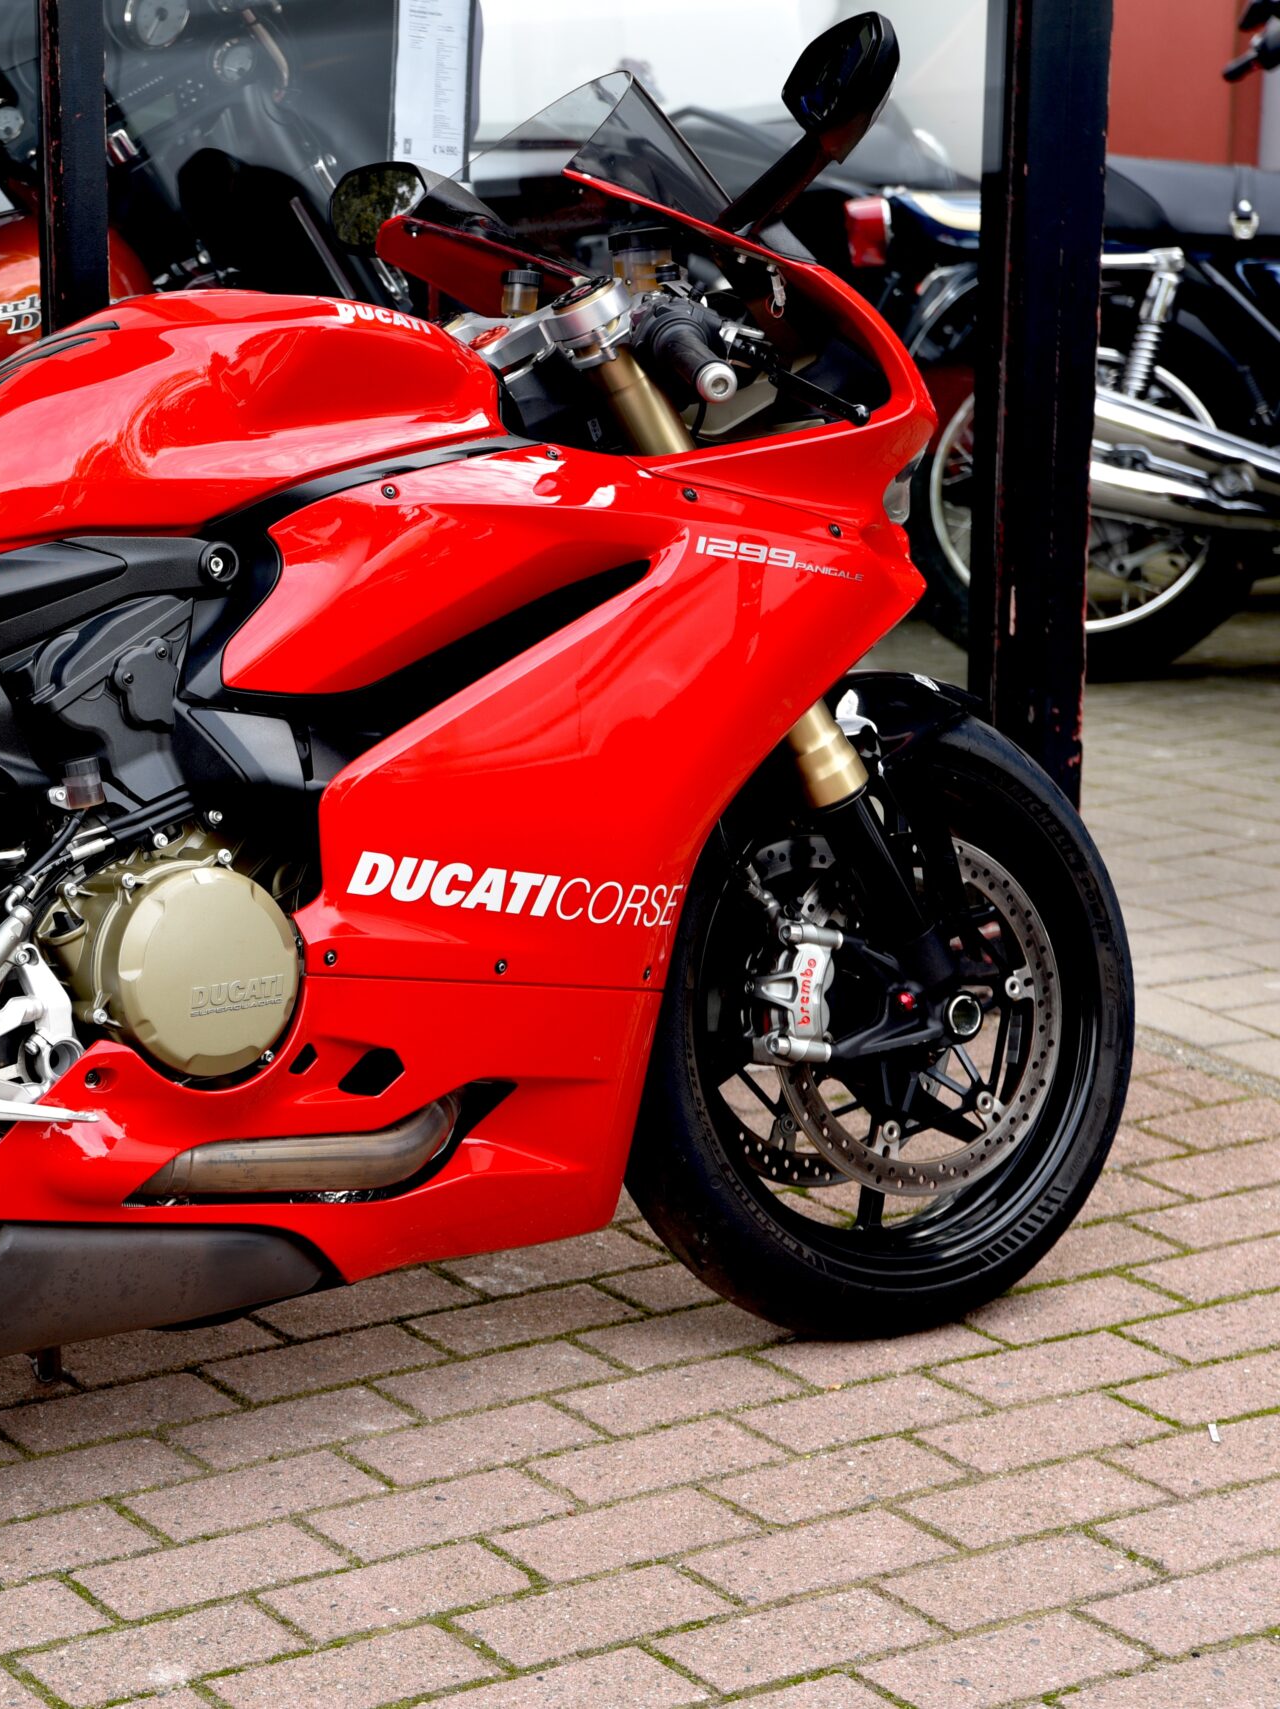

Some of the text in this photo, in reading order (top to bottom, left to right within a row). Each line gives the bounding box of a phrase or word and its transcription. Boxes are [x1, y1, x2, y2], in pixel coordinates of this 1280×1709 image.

[335, 302, 431, 334] DUCATI
[695, 535, 864, 582] 1299 PANIGALE
[346, 850, 684, 928] DUCATI CORSE
[190, 997, 283, 1018] SUPERQUADRO
[191, 973, 284, 1010] DUCATI
[797, 958, 816, 1027] brembo
[723, 1169, 798, 1250] MICHELIN
